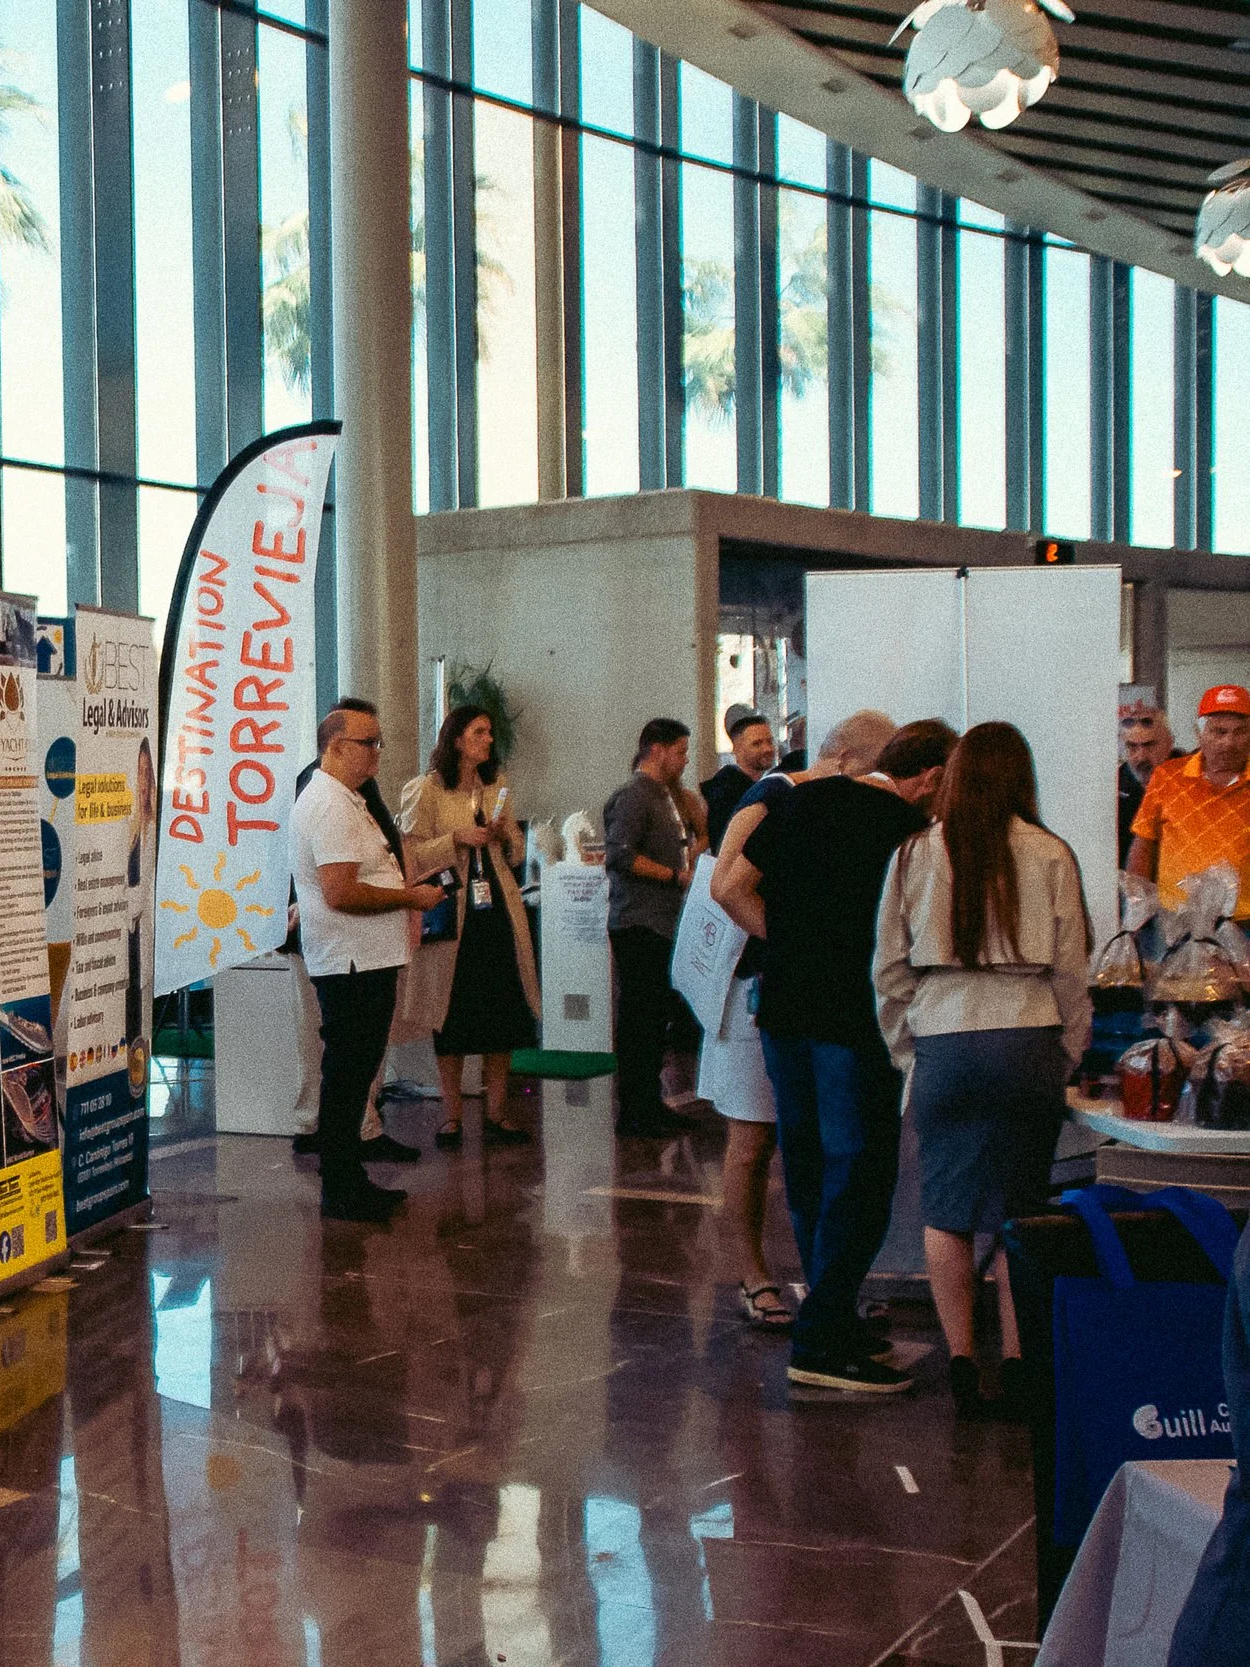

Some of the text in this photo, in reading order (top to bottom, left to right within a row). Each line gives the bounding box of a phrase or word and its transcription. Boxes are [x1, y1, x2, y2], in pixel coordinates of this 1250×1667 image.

[104, 640, 149, 692] BEST
[226, 440, 318, 846] TORREVIEJA
[82, 696, 149, 735] Legal & Advisors
[169, 549, 231, 843] DESTINATION
[78, 779, 97, 798] Legal
